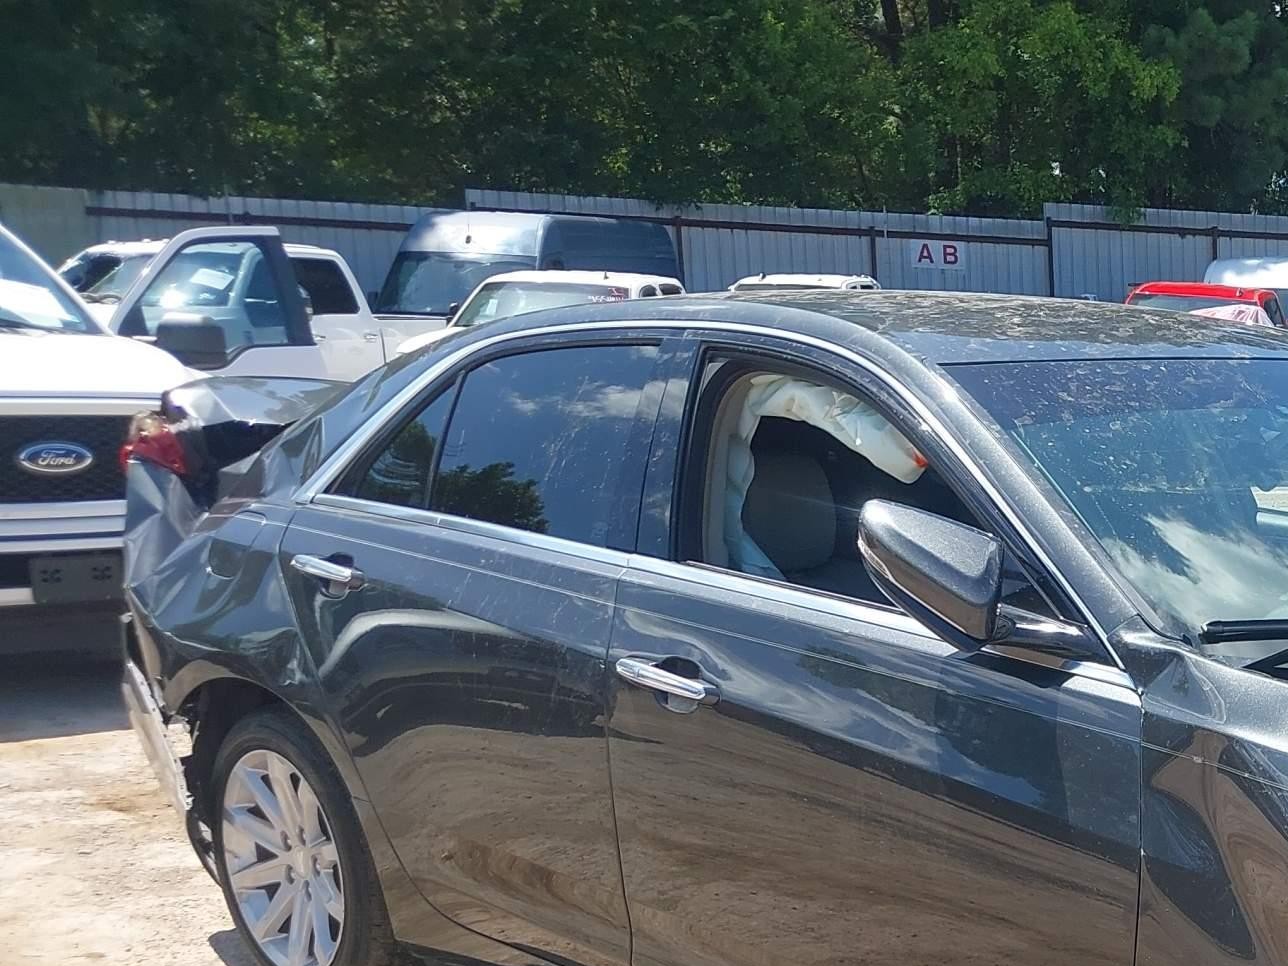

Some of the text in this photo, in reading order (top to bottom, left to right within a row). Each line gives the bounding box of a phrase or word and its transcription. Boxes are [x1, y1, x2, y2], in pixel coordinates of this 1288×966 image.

[918, 243, 958, 264] A B
[38, 449, 78, 465] Ford
